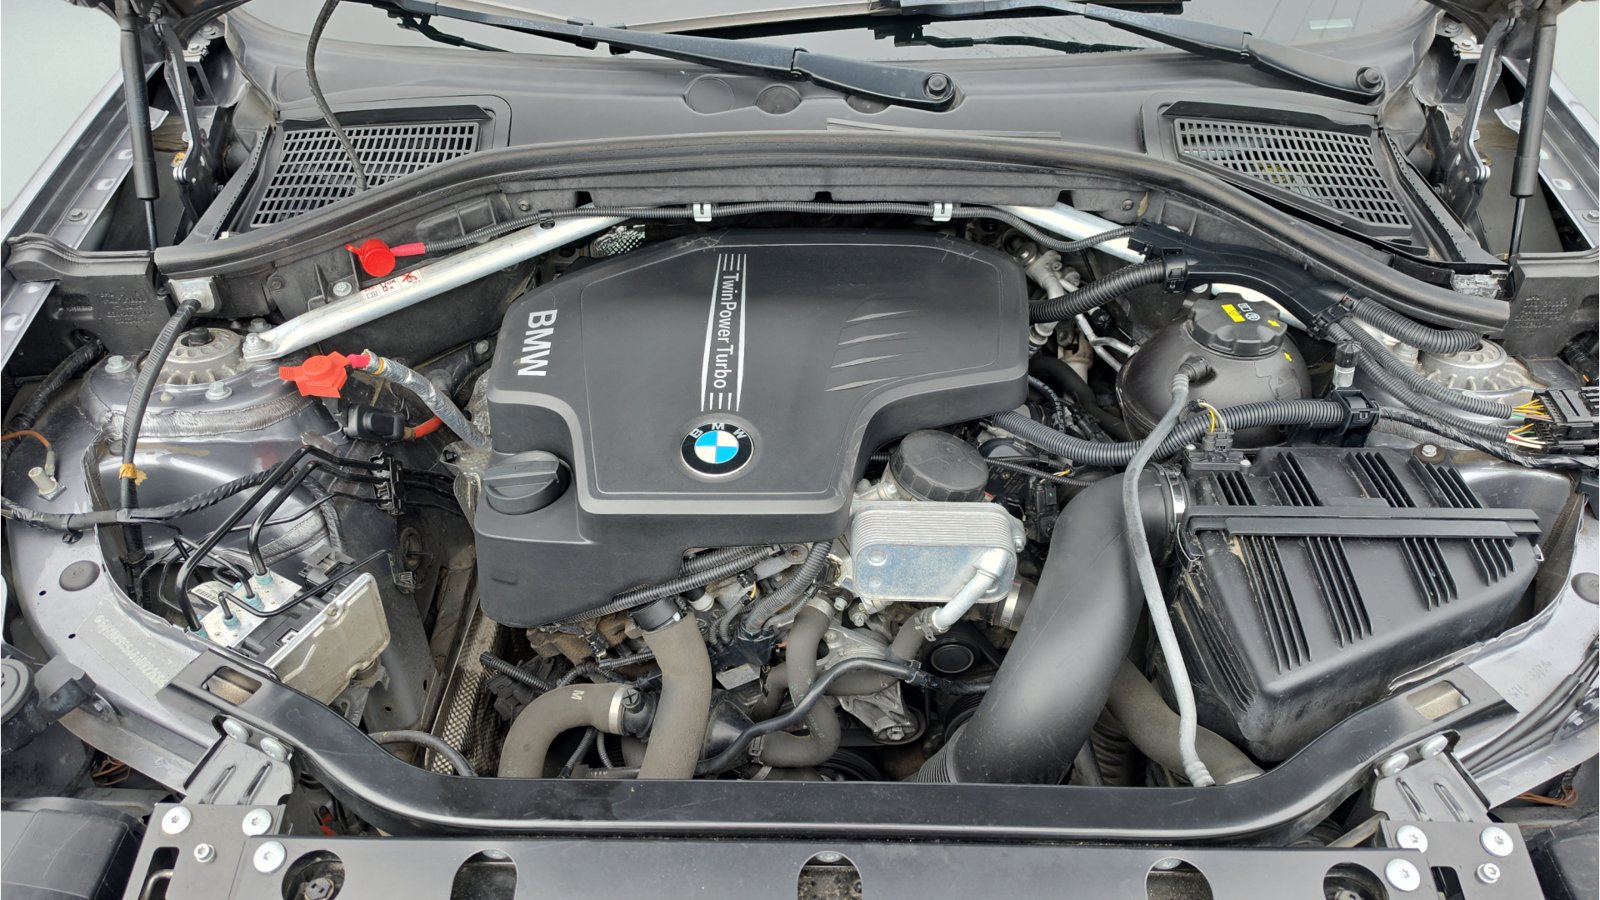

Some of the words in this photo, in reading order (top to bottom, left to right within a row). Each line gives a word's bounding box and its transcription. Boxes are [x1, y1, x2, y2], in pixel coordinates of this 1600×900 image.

[717, 272, 740, 344] TwinPower
[517, 309, 558, 377] BMW
[713, 344, 734, 389] Turbo
[689, 422, 747, 439] BMW
